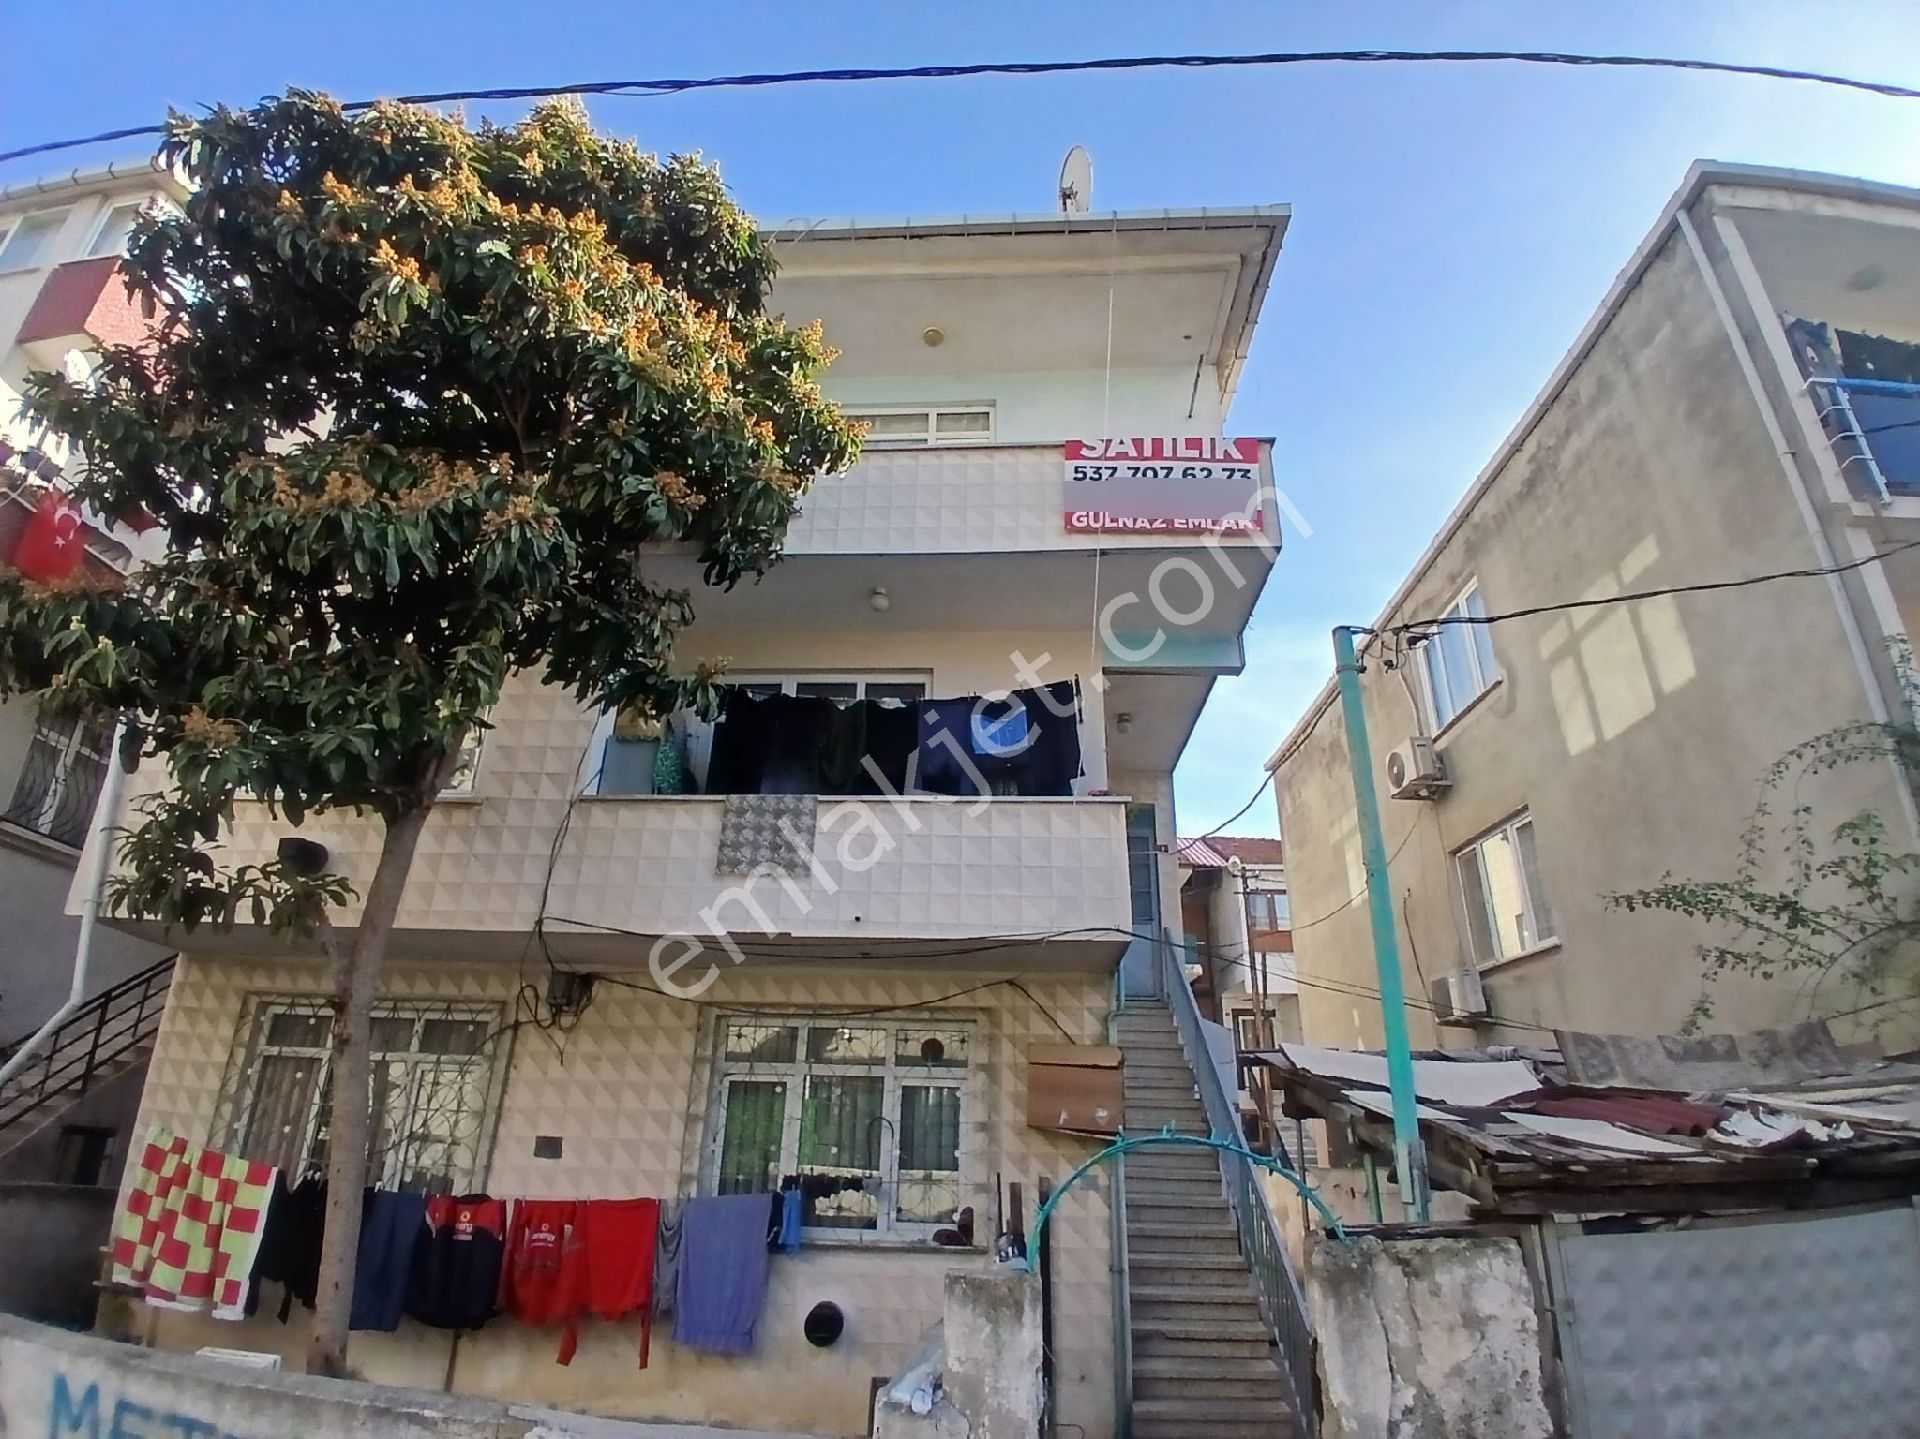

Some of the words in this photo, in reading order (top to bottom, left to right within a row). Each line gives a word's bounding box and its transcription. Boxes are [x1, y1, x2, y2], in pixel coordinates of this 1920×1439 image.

[1073, 466, 1118, 481] 537
[1127, 466, 1174, 479] 707
[1181, 467, 1213, 480] 62
[1221, 468, 1251, 480] 73
